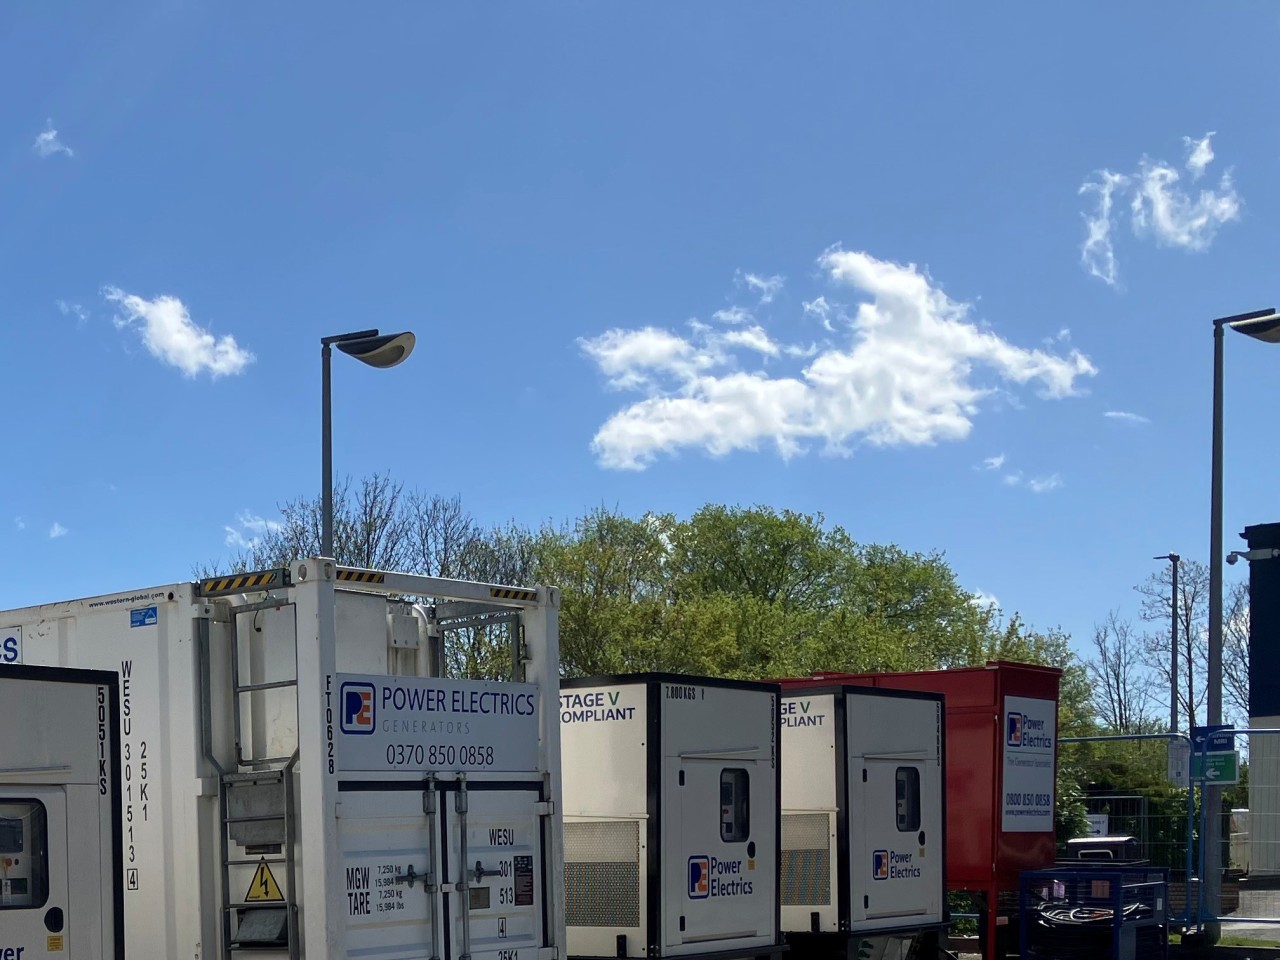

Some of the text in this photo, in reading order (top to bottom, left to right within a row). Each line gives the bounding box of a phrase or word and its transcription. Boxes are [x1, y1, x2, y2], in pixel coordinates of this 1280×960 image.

[122, 661, 132, 736] WESU
[382, 687, 535, 716] POWER ELECTRICS
[608, 691, 620, 706] V
[800, 701, 811, 714] V
[560, 707, 636, 723] OMPLIANT
[1023, 714, 1045, 731] Power
[325, 675, 334, 774] FT0628
[382, 719, 470, 735] GENERATORS
[97, 687, 107, 795] 5051KS
[1022, 731, 1052, 748] Electrics
[386, 744, 494, 766] 0370 850 0858
[140, 742, 149, 821] 25K1
[124, 743, 135, 863] 301513
[489, 828, 514, 846] WESU
[711, 856, 742, 875] Power
[890, 850, 913, 864] Power
[499, 860, 513, 878] 301
[890, 864, 921, 879] Electrics
[346, 867, 370, 890] MGW
[711, 877, 753, 897] Electrics
[347, 892, 370, 915] TARE
[499, 887, 514, 904] 513
